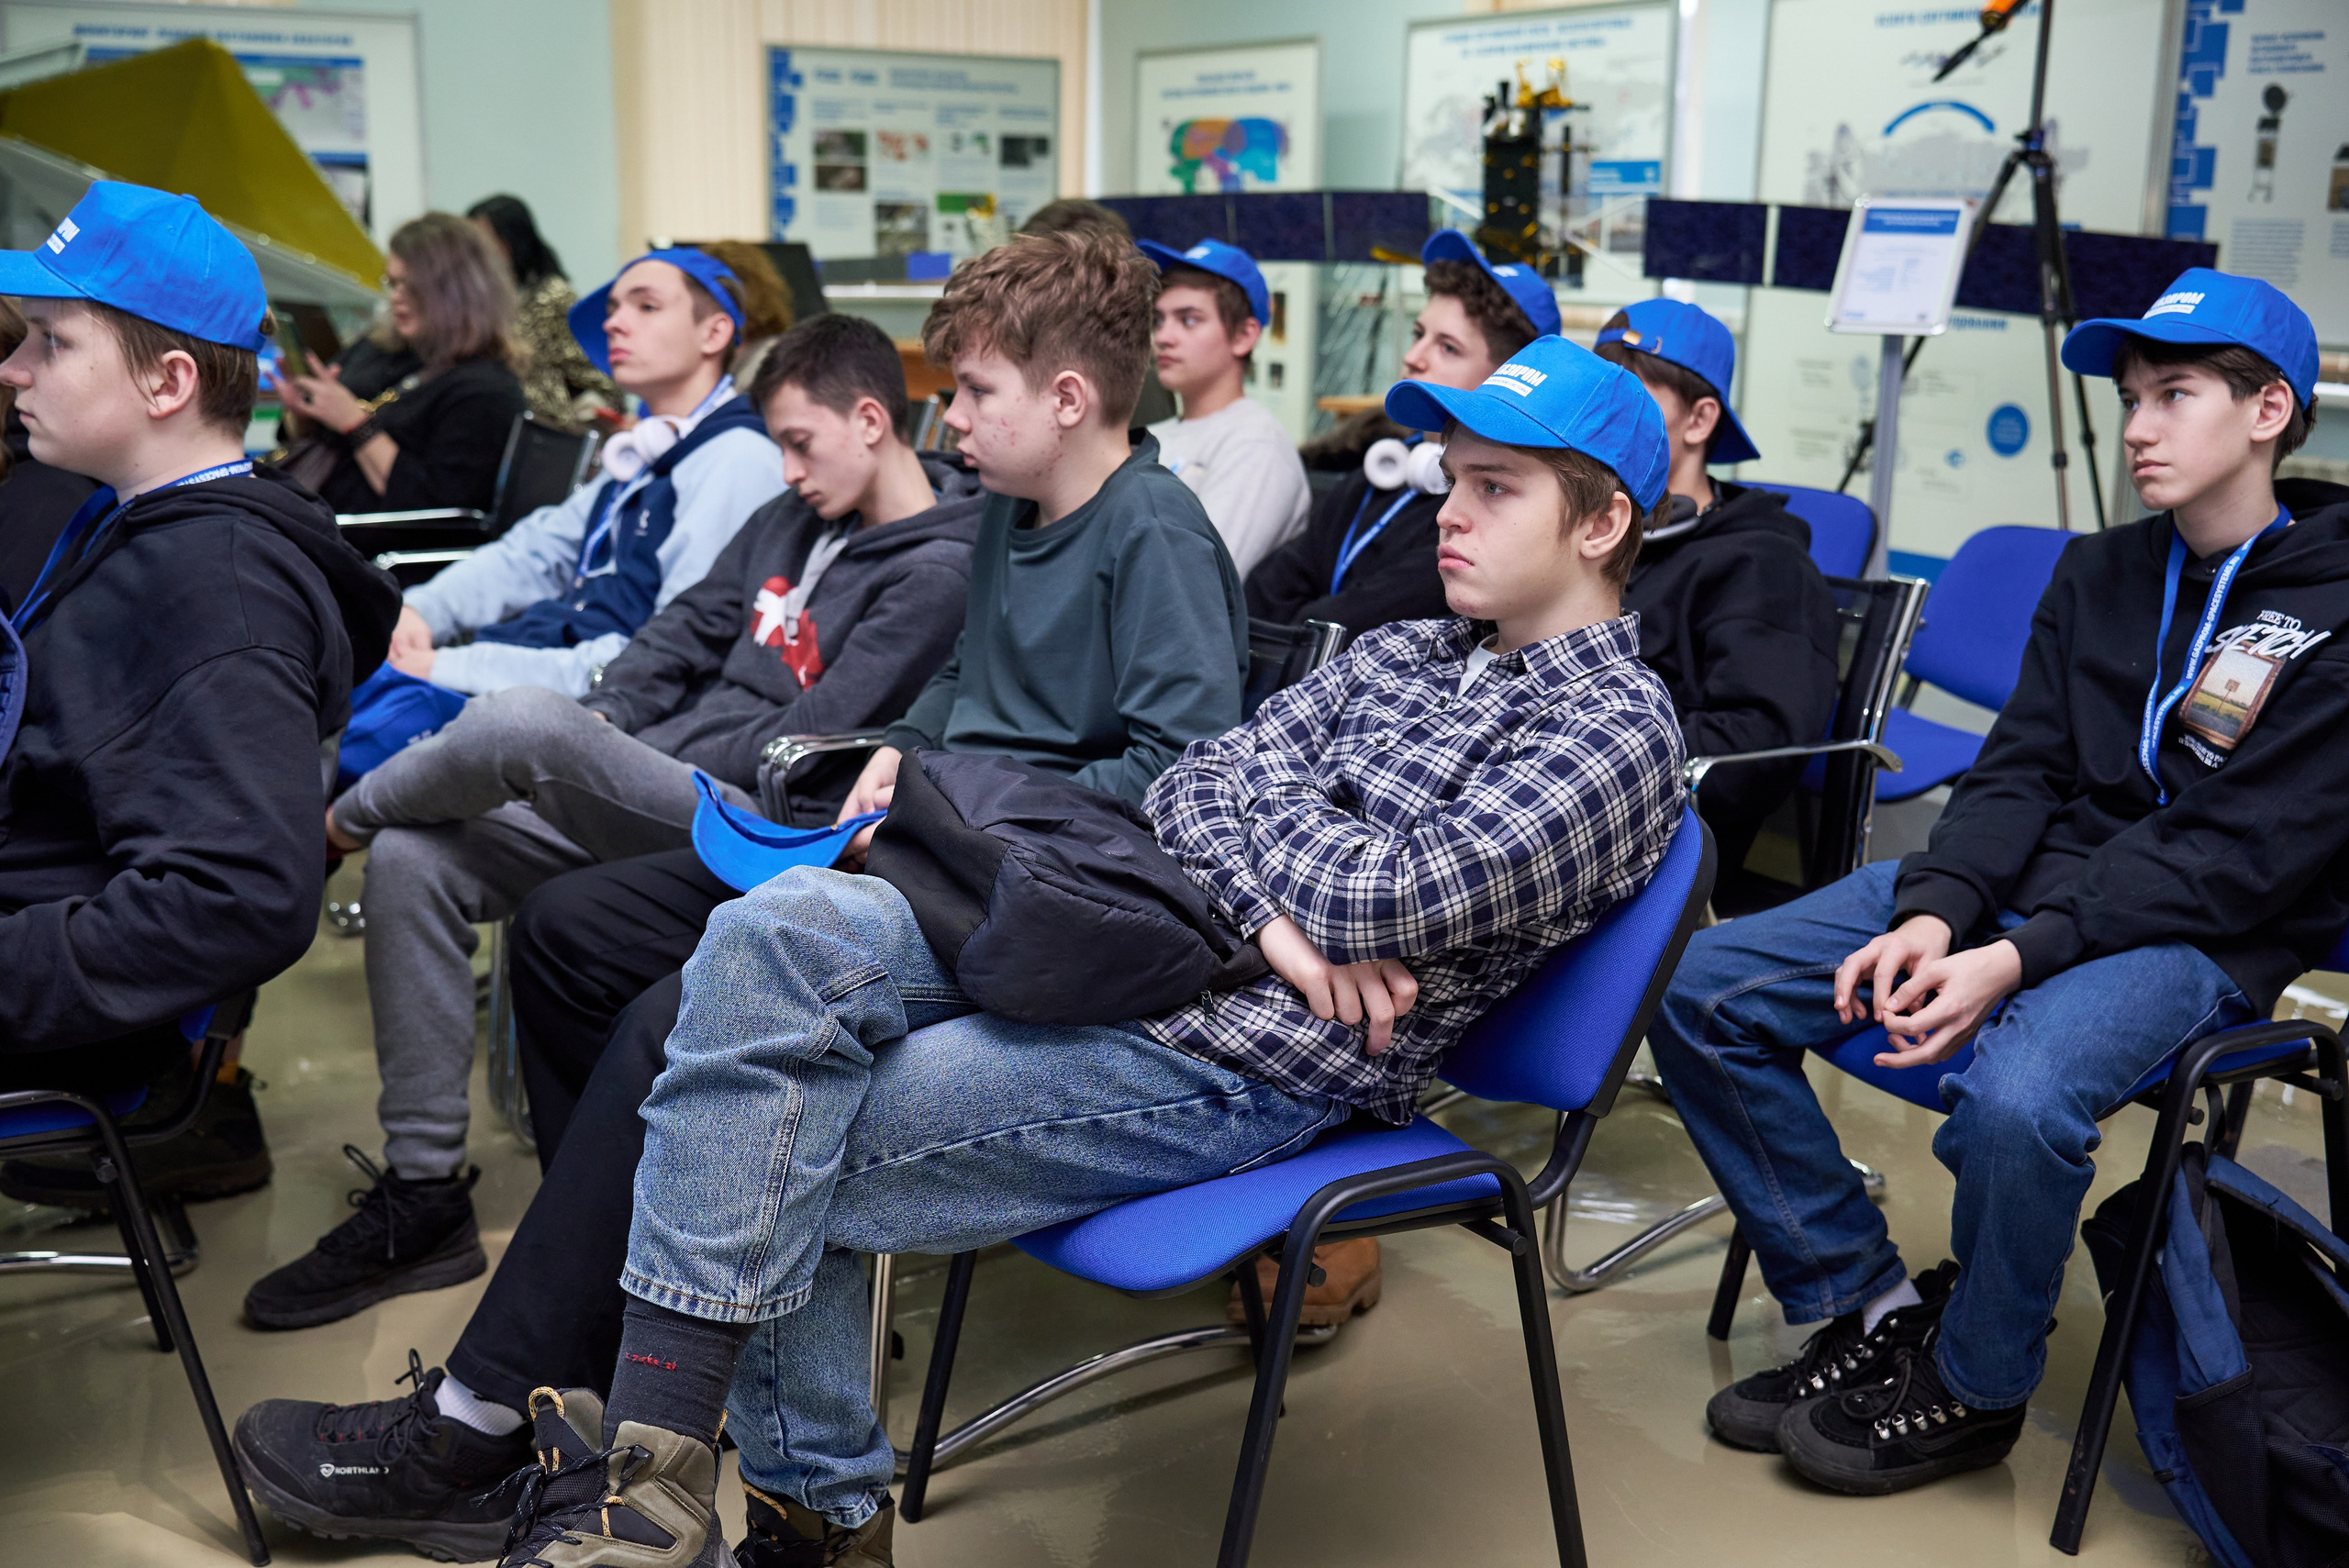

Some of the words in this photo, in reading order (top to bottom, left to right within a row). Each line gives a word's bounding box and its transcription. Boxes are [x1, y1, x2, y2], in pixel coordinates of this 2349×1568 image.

[2186, 555, 2240, 680] WWW.GAZPROM-SPACESYSTEMS.RU
[2256, 609, 2285, 625] FREE
[2282, 615, 2302, 631] TO
